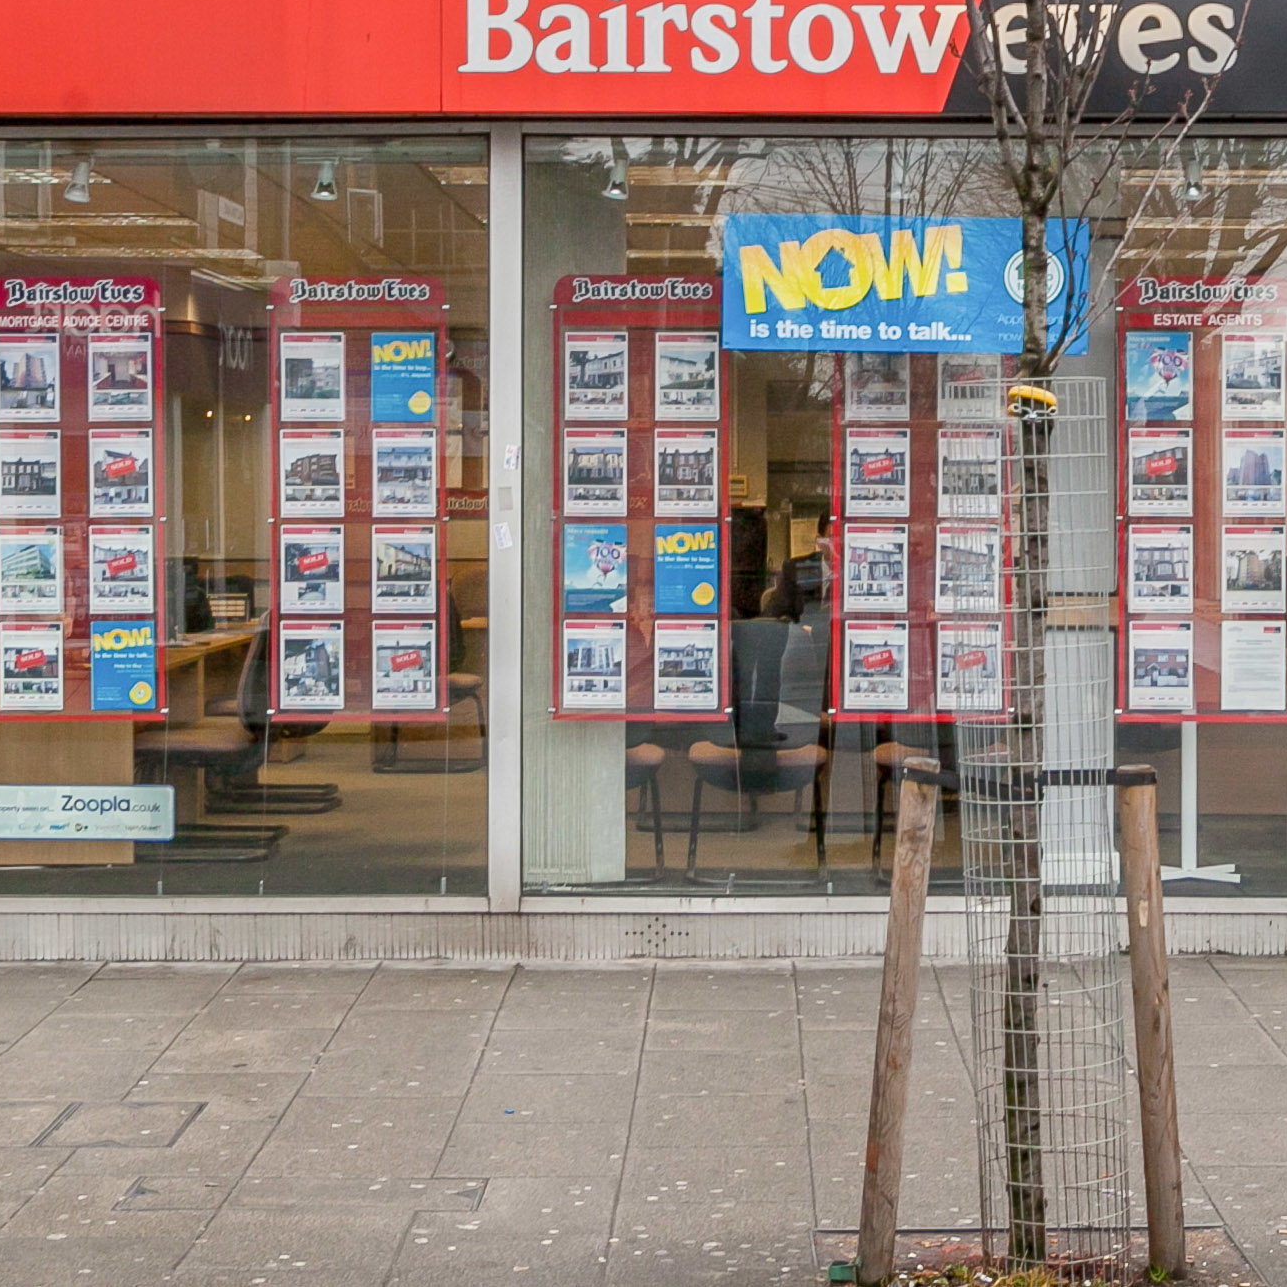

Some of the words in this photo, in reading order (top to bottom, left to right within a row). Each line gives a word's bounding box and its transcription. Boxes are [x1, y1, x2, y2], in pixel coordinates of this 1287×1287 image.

[986, 2, 1238, 76] eves
[739, 224, 969, 315] NOW!
[5, 279, 97, 306] Bairstow
[96, 278, 145, 304] Eves
[289, 278, 383, 303] Bairstow
[383, 277, 430, 301] Eves
[572, 277, 666, 303] Bairstow
[666, 277, 713, 301] Eves
[1137, 277, 1228, 305] Bairstow
[1228, 276, 1278, 303] Eves
[63, 314, 101, 328] ADVICE
[104, 314, 149, 328] CENTRE
[749, 319, 770, 338] is
[775, 319, 814, 339] the
[819, 321, 872, 340] time
[878, 322, 902, 340] to
[908, 322, 972, 342] talk...
[1153, 314, 1202, 326] ESTATE
[1208, 314, 1262, 326] AGENTS
[373, 339, 432, 363] NOW!
[595, 546, 621, 560] 100
[656, 530, 716, 554] NOW!
[93, 627, 153, 652] NOW!
